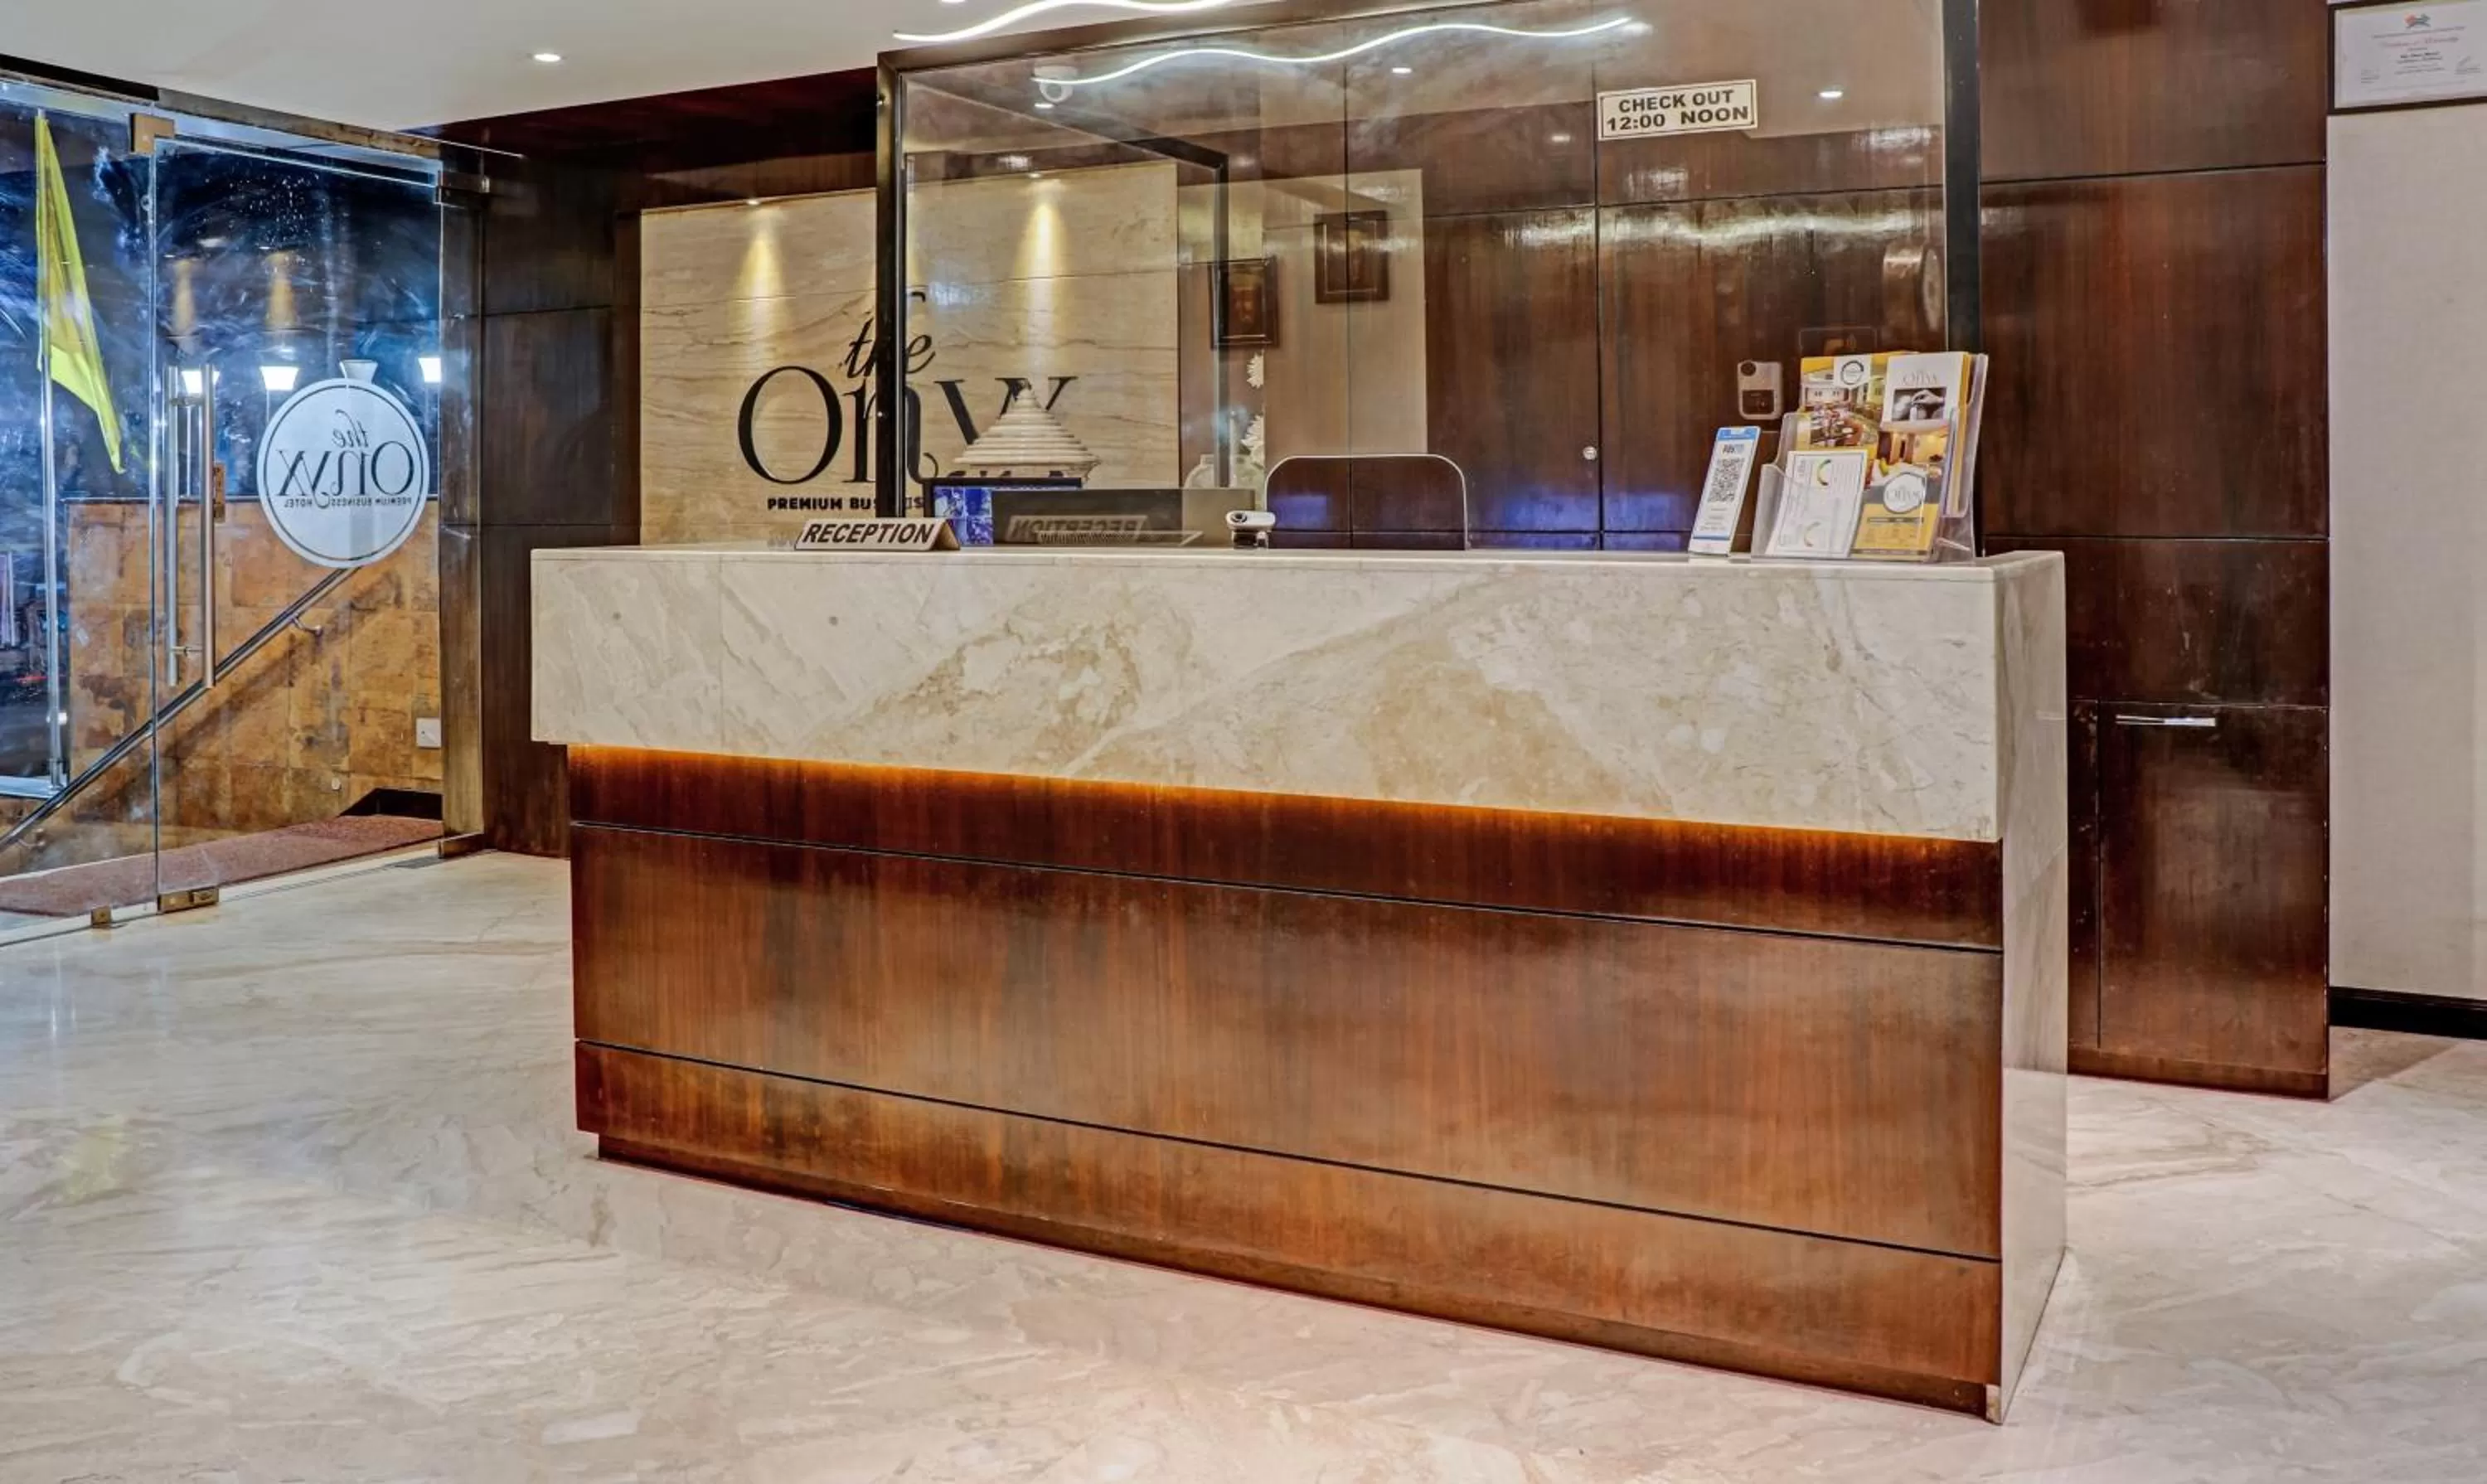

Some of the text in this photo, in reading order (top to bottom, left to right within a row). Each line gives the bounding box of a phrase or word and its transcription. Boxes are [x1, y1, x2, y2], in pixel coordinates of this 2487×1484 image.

[1618, 90, 1734, 113] CHECK OUT
[1607, 106, 1748, 131] 12:00 NOON
[767, 497, 843, 511] PREMIUM
[802, 523, 935, 544] RECEPTION
